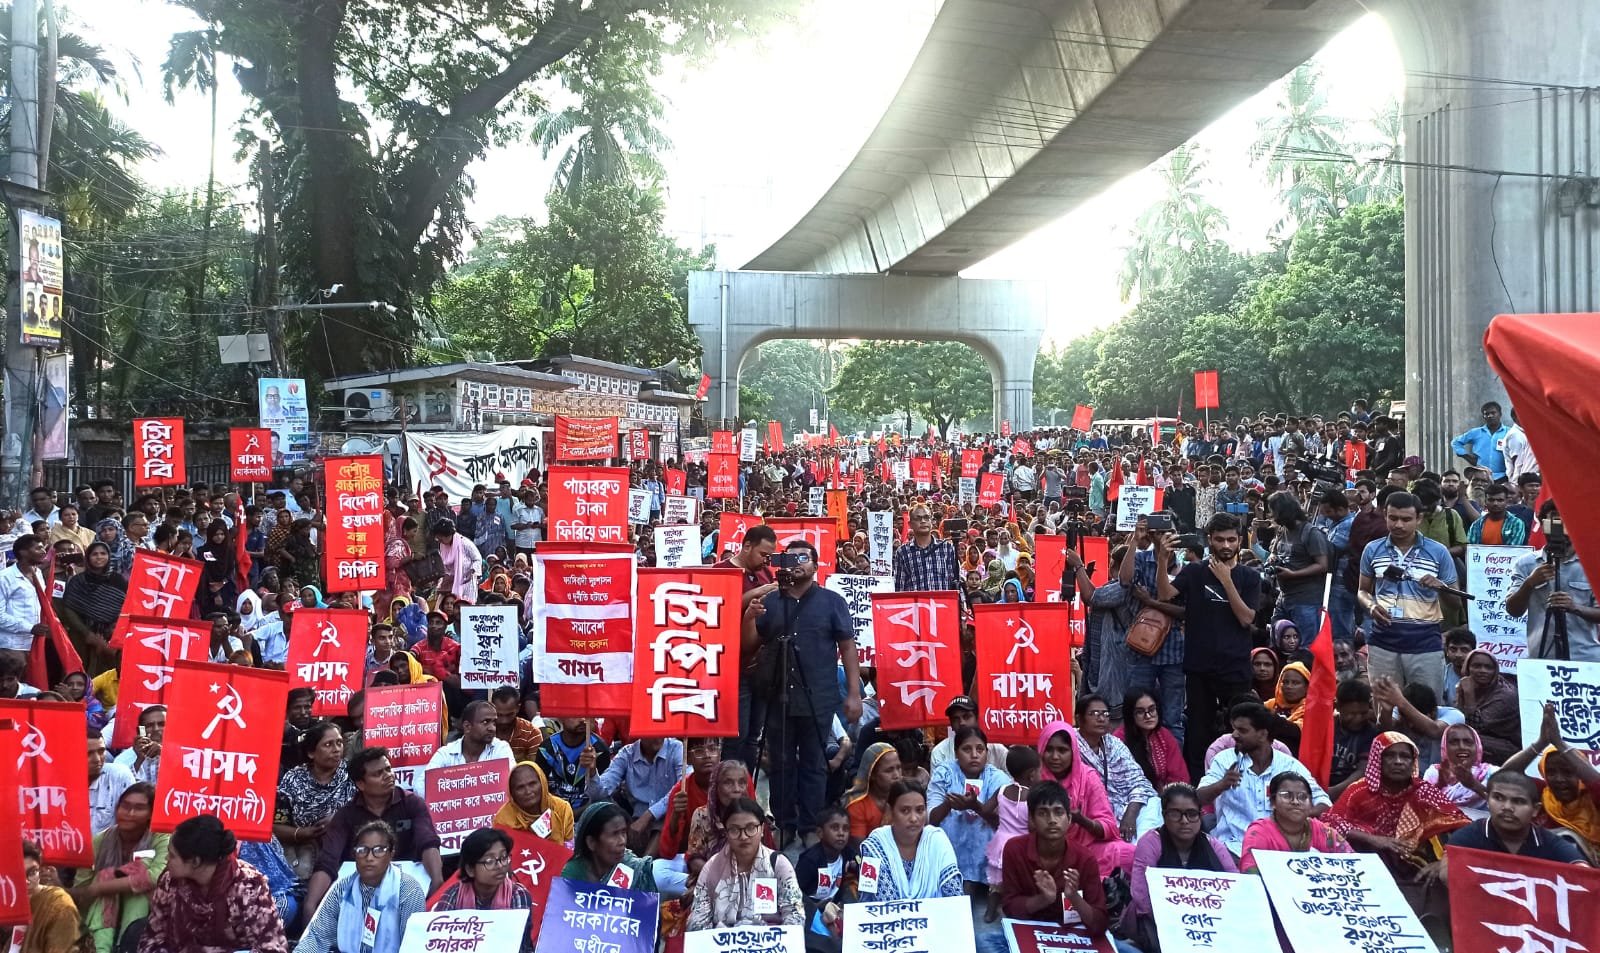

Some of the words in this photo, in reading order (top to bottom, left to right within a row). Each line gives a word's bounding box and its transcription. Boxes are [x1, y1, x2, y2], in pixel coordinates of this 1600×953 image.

[238, 454, 264, 464] বাসদ
[339, 462, 370, 477] দেশীয়
[335, 475, 381, 492] রাজনীতিতে
[563, 477, 621, 498] পাচারকৃত
[338, 493, 379, 511] বিদেশী
[574, 496, 608, 516] টাকা
[342, 514, 382, 528] হস্তক্ষেপ
[347, 532, 367, 542] বন্ধ
[555, 520, 597, 541] ফিরিয়ে
[346, 545, 367, 556] কর
[338, 560, 379, 579] সিপিবি
[570, 621, 605, 635] সমাবেশ
[570, 638, 587, 650] সফল
[589, 638, 609, 649] করুন
[297, 662, 349, 682] বাসদ
[558, 658, 604, 682] বাসদ
[1546, 665, 1579, 681] মত
[990, 673, 1053, 698] বাসদ
[369, 702, 403, 718] সাম্প্রদায়িক
[404, 698, 430, 714] রাজনীতি
[431, 702, 437, 711] ও
[365, 723, 398, 739] রাজনীতিতে
[400, 721, 416, 736] ধর্মের
[417, 722, 438, 735] ব্যবহার
[422, 744, 432, 754] কর
[181, 746, 259, 784] বাসদ
[437, 774, 478, 792] বিইআরসির
[479, 771, 500, 784] আইন
[164, 786, 266, 823] (মার্কসবাদী)
[429, 798, 462, 813] সংশোধন
[464, 795, 480, 808] করে
[482, 791, 506, 804] ক্ষমতা
[455, 818, 470, 829] করা
[472, 814, 493, 828] চলবে
[574, 889, 634, 914] হাসিনা
[1308, 888, 1372, 902] যাওয়ার
[865, 901, 922, 917] হাসিনা
[426, 915, 494, 935] নির্দলীয়
[563, 910, 641, 938] সরকারের
[1182, 913, 1222, 928] রোধ
[712, 927, 787, 946] আওয়ামী
[1185, 928, 1217, 944] কর
